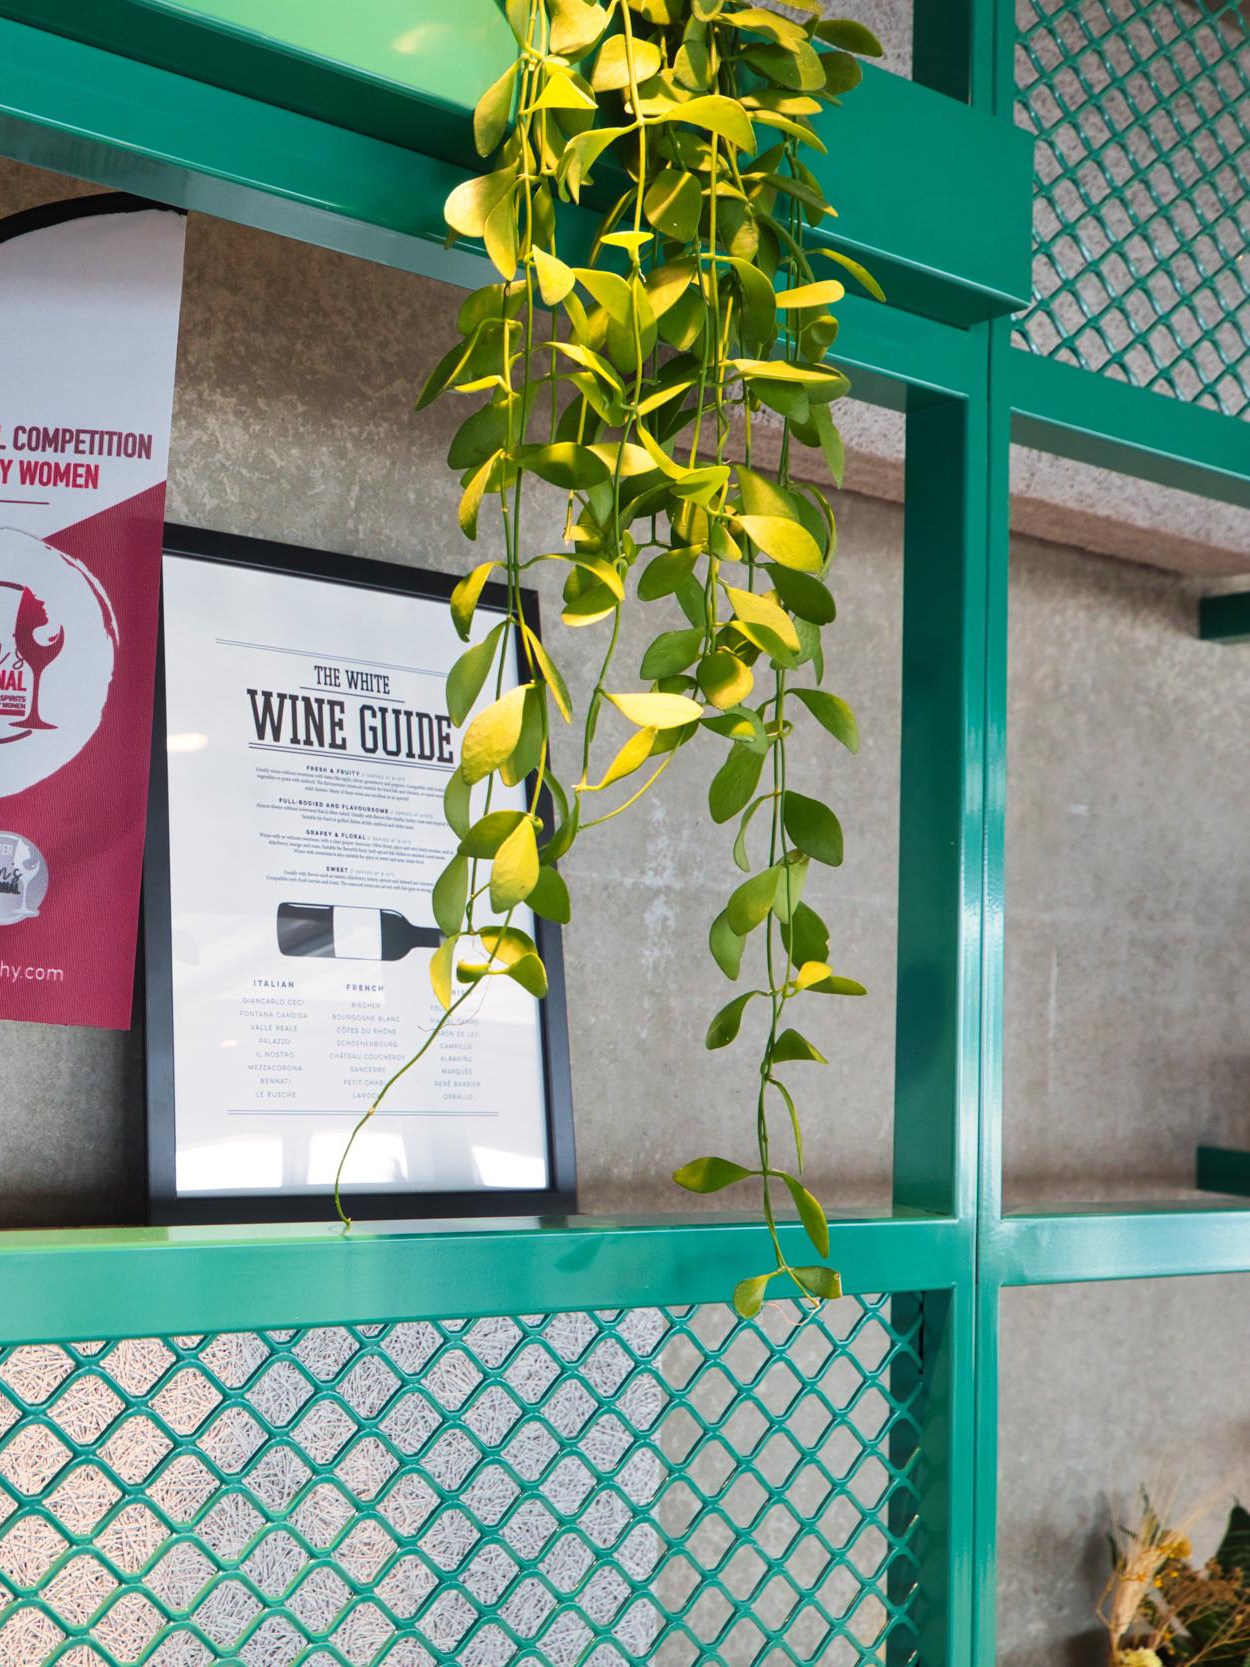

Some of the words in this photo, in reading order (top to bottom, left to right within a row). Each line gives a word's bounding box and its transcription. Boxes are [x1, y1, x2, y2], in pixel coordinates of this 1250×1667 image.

[12, 425, 153, 460] COMPETITION
[18, 459, 100, 490] WOMEN
[313, 665, 341, 688] THE
[344, 669, 390, 695] WHITE
[0, 694, 26, 702] SPIRITS
[246, 688, 347, 751] WINE
[359, 704, 454, 764] GUIDE
[306, 765, 328, 773] FRESH
[336, 768, 360, 776] FRUITY
[278, 797, 324, 807] FULL-BODIED
[341, 804, 389, 814] FLAVOURSOME
[305, 829, 332, 837] GRAPEY
[341, 832, 366, 840] FLORAL
[326, 865, 348, 873] SWEET
[253, 979, 295, 989] ITALIAN
[346, 984, 384, 992] FRENCH
[242, 997, 285, 1006] GIANCARLO
[239, 1010, 274, 1018] FONTANA
[276, 1011, 308, 1019] CANDIDA
[331, 1013, 375, 1022] BOURGOGNE
[377, 1015, 400, 1023] BLANC
[250, 1024, 273, 1032] VALLE
[336, 1026, 359, 1034] CÔTES
[373, 1027, 396, 1035] RHÔNE
[258, 1037, 291, 1045] PALAZZO
[264, 1051, 295, 1059] NOSTRO
[248, 1064, 303, 1072] MEZZACORONA
[260, 1077, 292, 1085] BENNATI
[267, 1091, 297, 1099] BUSCHE
